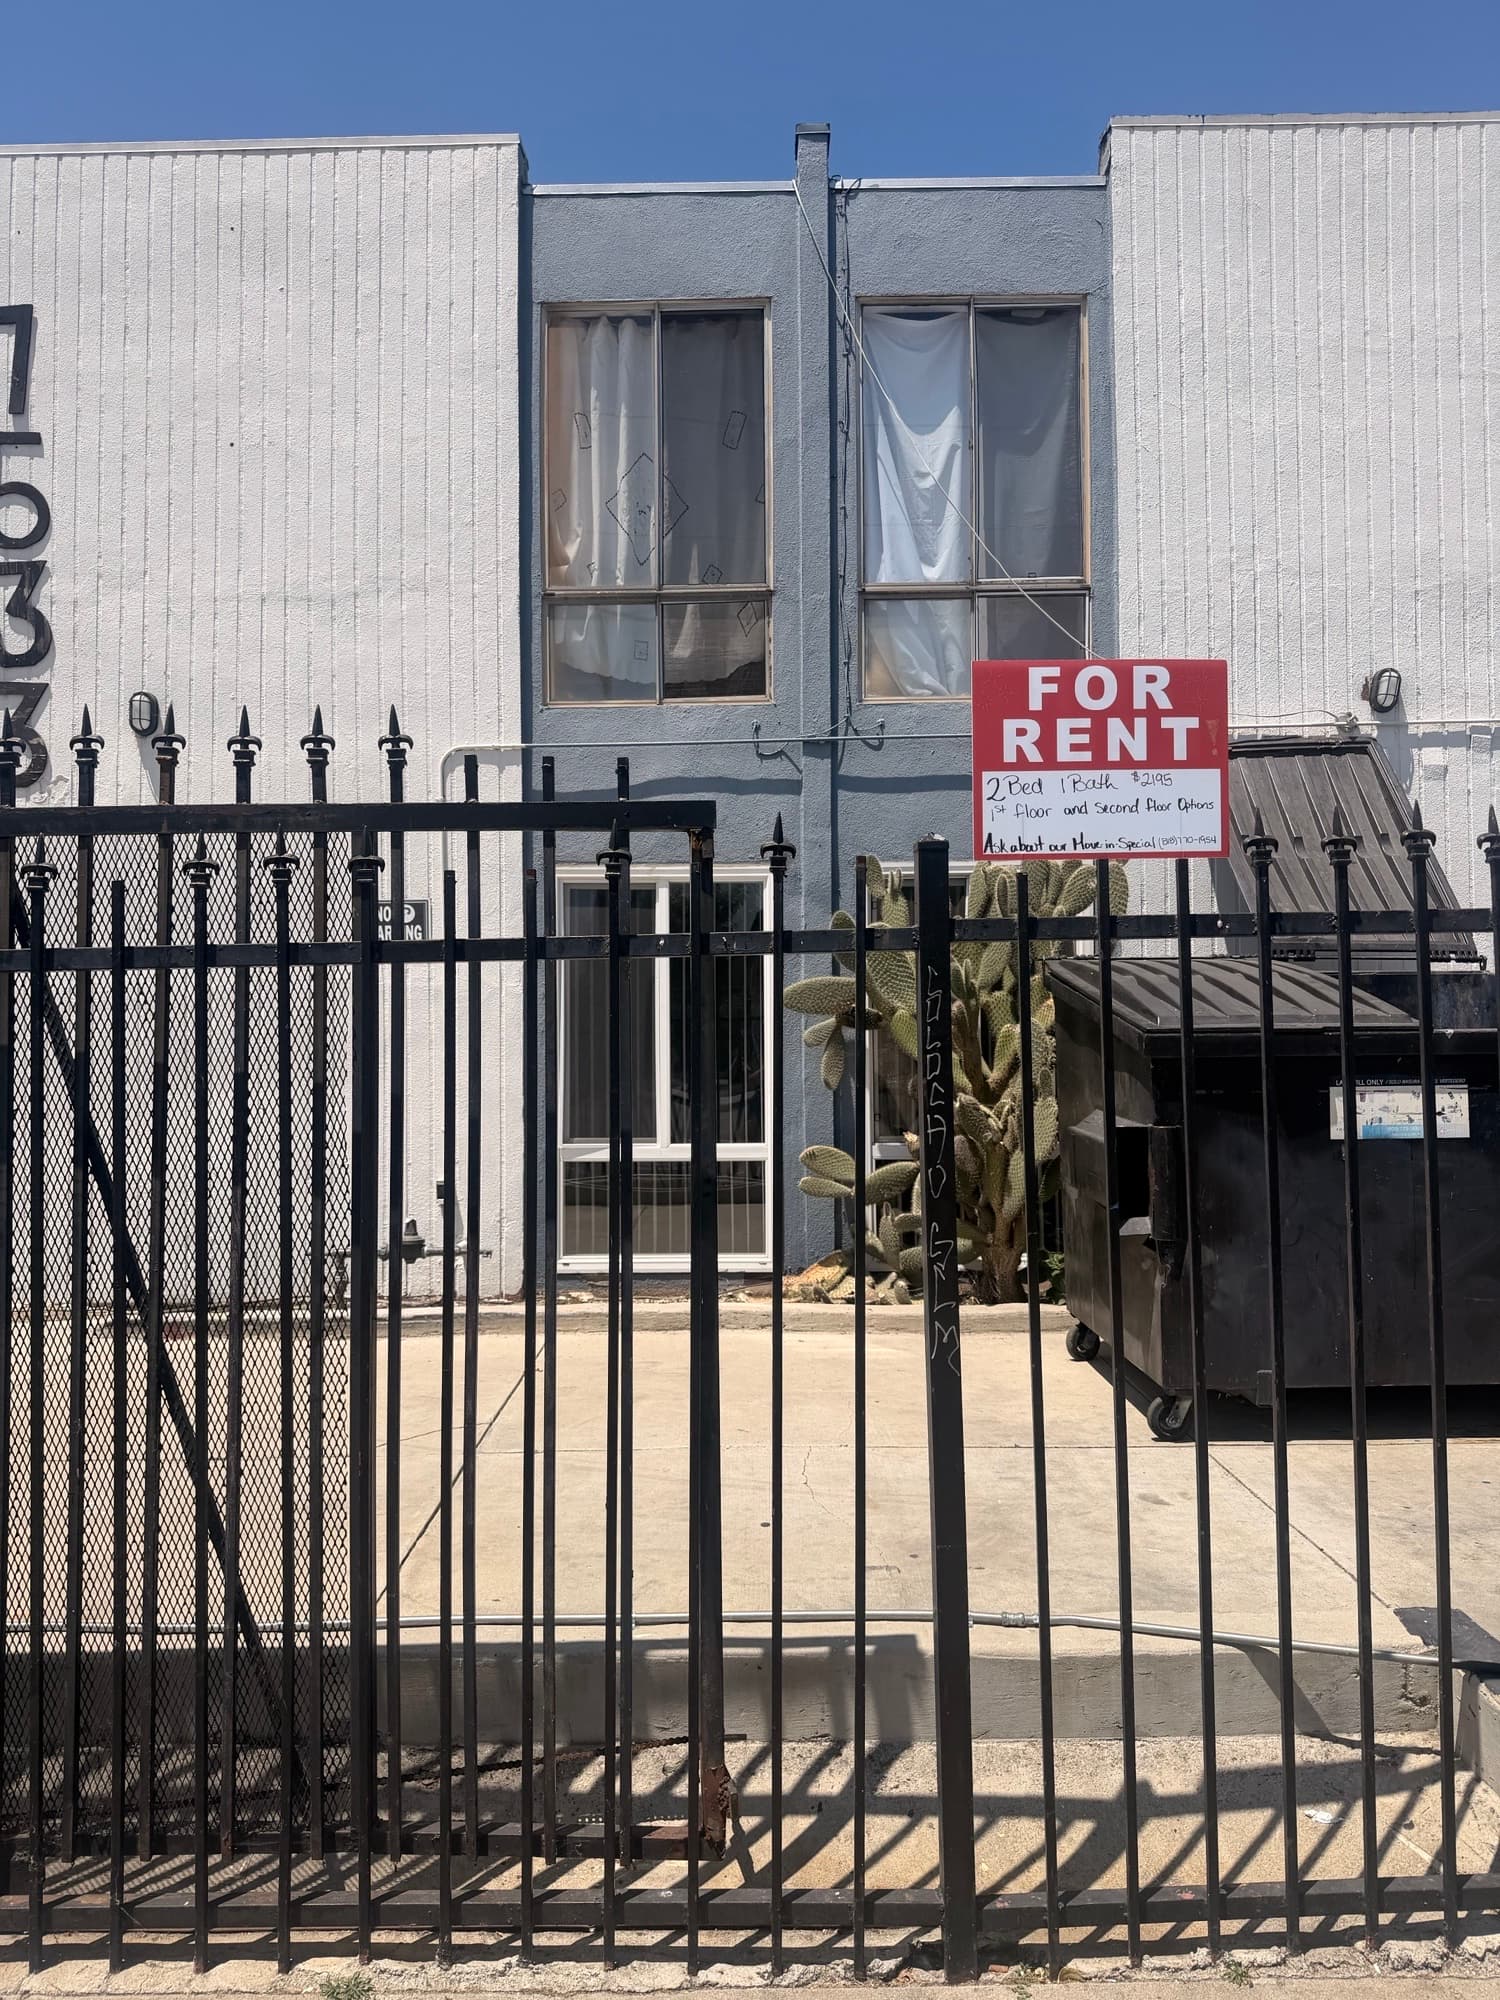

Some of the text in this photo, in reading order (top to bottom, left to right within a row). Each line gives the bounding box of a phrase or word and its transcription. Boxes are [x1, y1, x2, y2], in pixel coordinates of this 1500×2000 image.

[1028, 665, 1173, 711] FOR
[986, 777, 1006, 802] 2
[1003, 775, 1043, 796] Bed
[1067, 773, 1119, 793] Bath
[1131, 771, 1173, 787] $2195
[991, 804, 1007, 822] 1st
[1014, 803, 1052, 818] floor
[1063, 800, 1088, 815] and
[1177, 797, 1214, 813] Options
[984, 832, 1008, 853] Ask
[1010, 835, 1044, 852] about
[1049, 843, 1067, 852] our
[378, 924, 423, 941] ARNG
